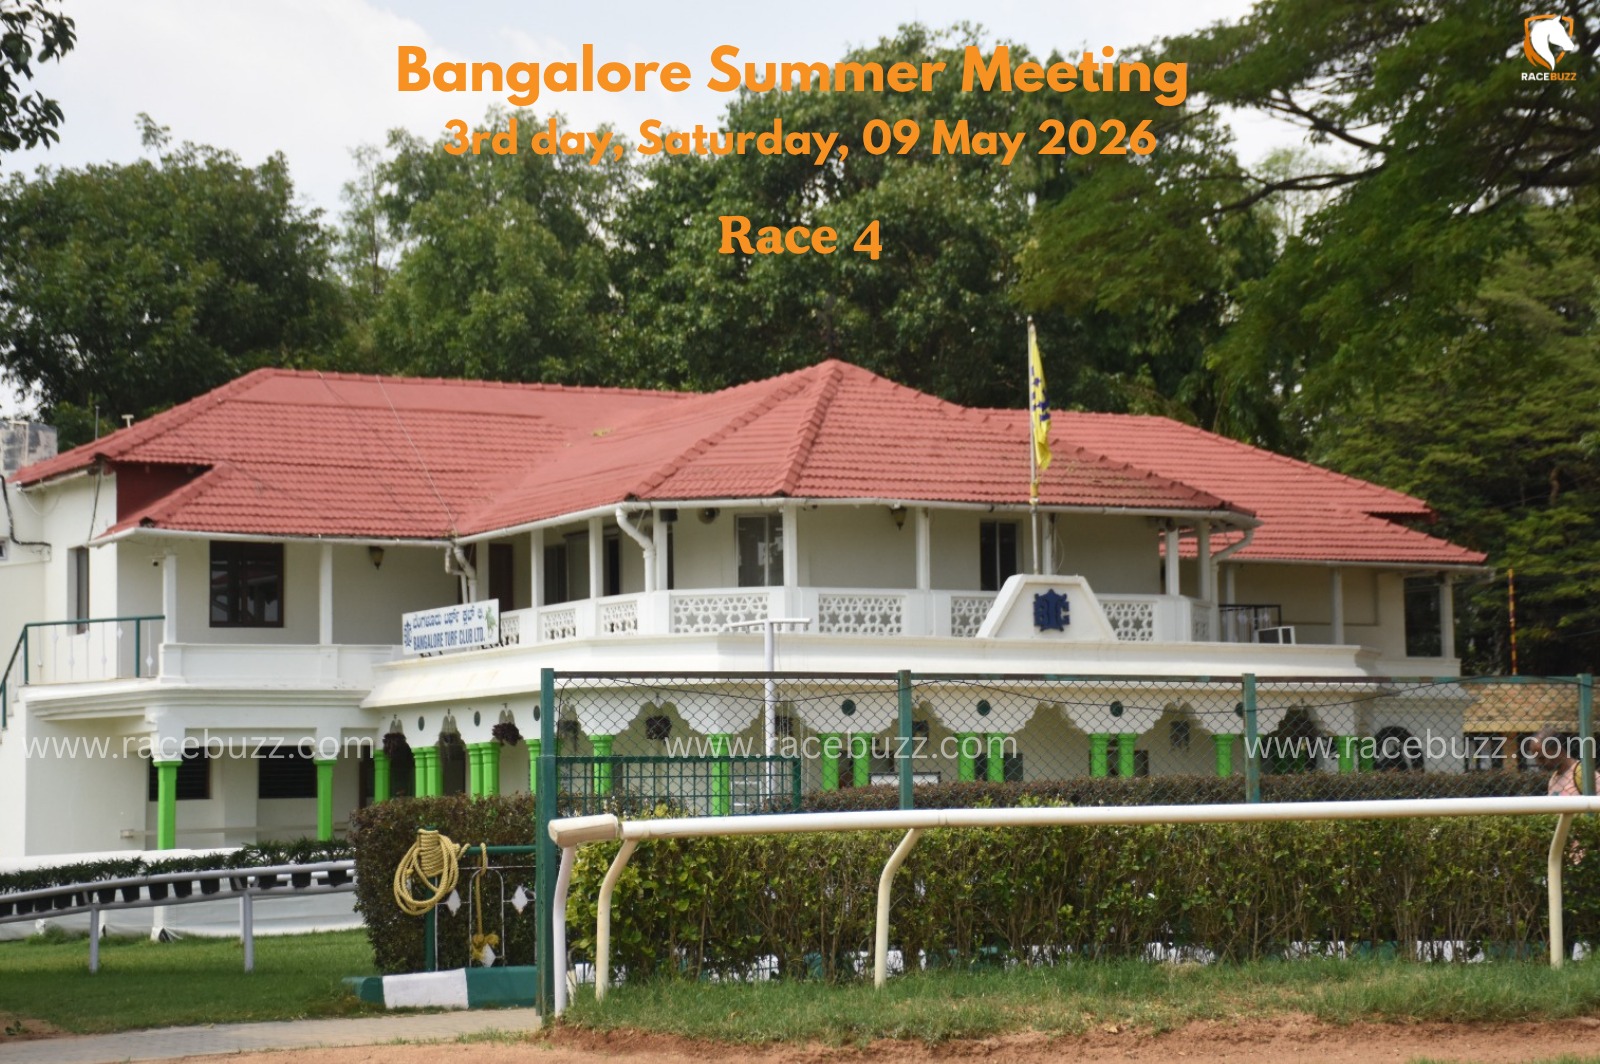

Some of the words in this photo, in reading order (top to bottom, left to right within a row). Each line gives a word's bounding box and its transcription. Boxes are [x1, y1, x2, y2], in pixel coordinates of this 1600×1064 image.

[413, 632, 444, 651] BANGALORE
[444, 630, 458, 647] TURF
[459, 627, 473, 645] CLUB
